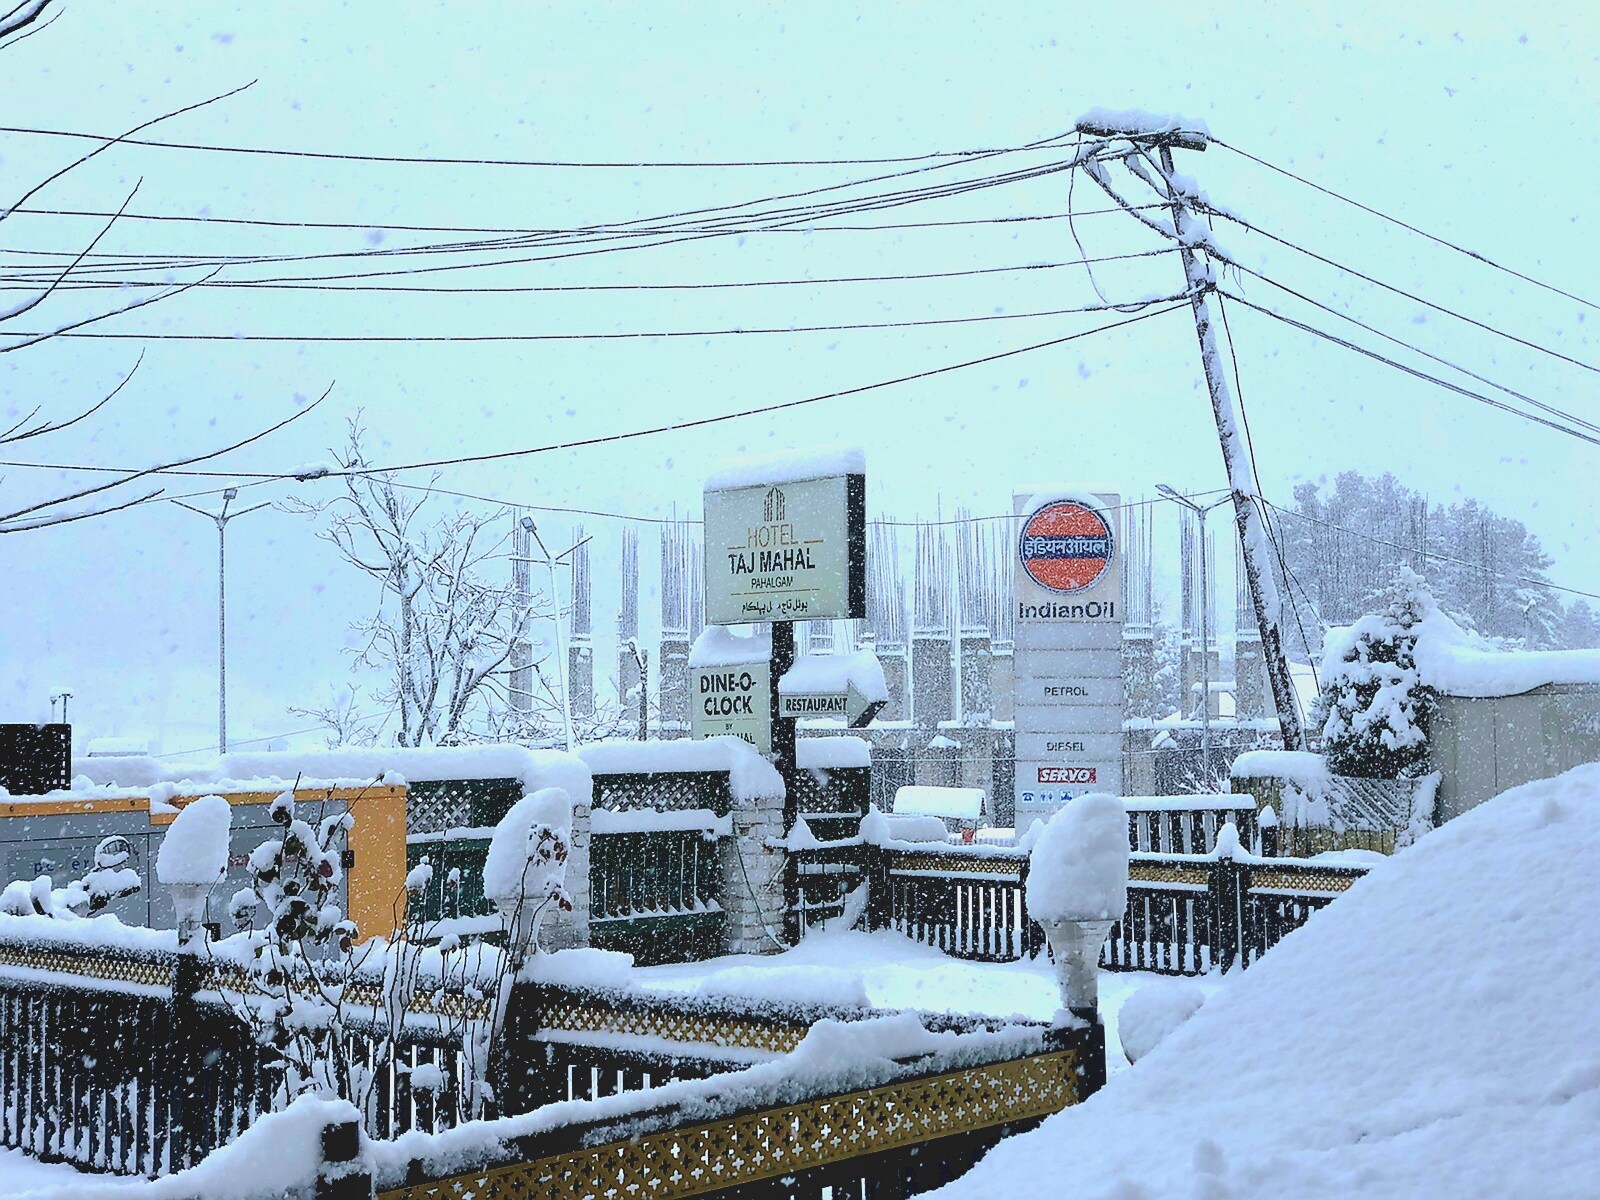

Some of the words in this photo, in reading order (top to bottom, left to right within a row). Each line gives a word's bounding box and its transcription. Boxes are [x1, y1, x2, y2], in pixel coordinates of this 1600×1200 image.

[747, 524, 798, 548] HOTEL
[1024, 536, 1106, 557] इंडियनऑयल
[728, 551, 755, 574] TAJ
[759, 548, 815, 573] MAHAL
[751, 576, 793, 589] PAHALGAM
[1019, 602, 1114, 618] IndianOil
[700, 672, 757, 693] DINE-O-
[1044, 686, 1089, 696] PETROL
[704, 695, 753, 716] CLOCK
[785, 697, 848, 712] RESTAURANT
[725, 723, 733, 731] BY
[1046, 742, 1085, 752] DIESEL
[1040, 769, 1091, 782] SERVO
